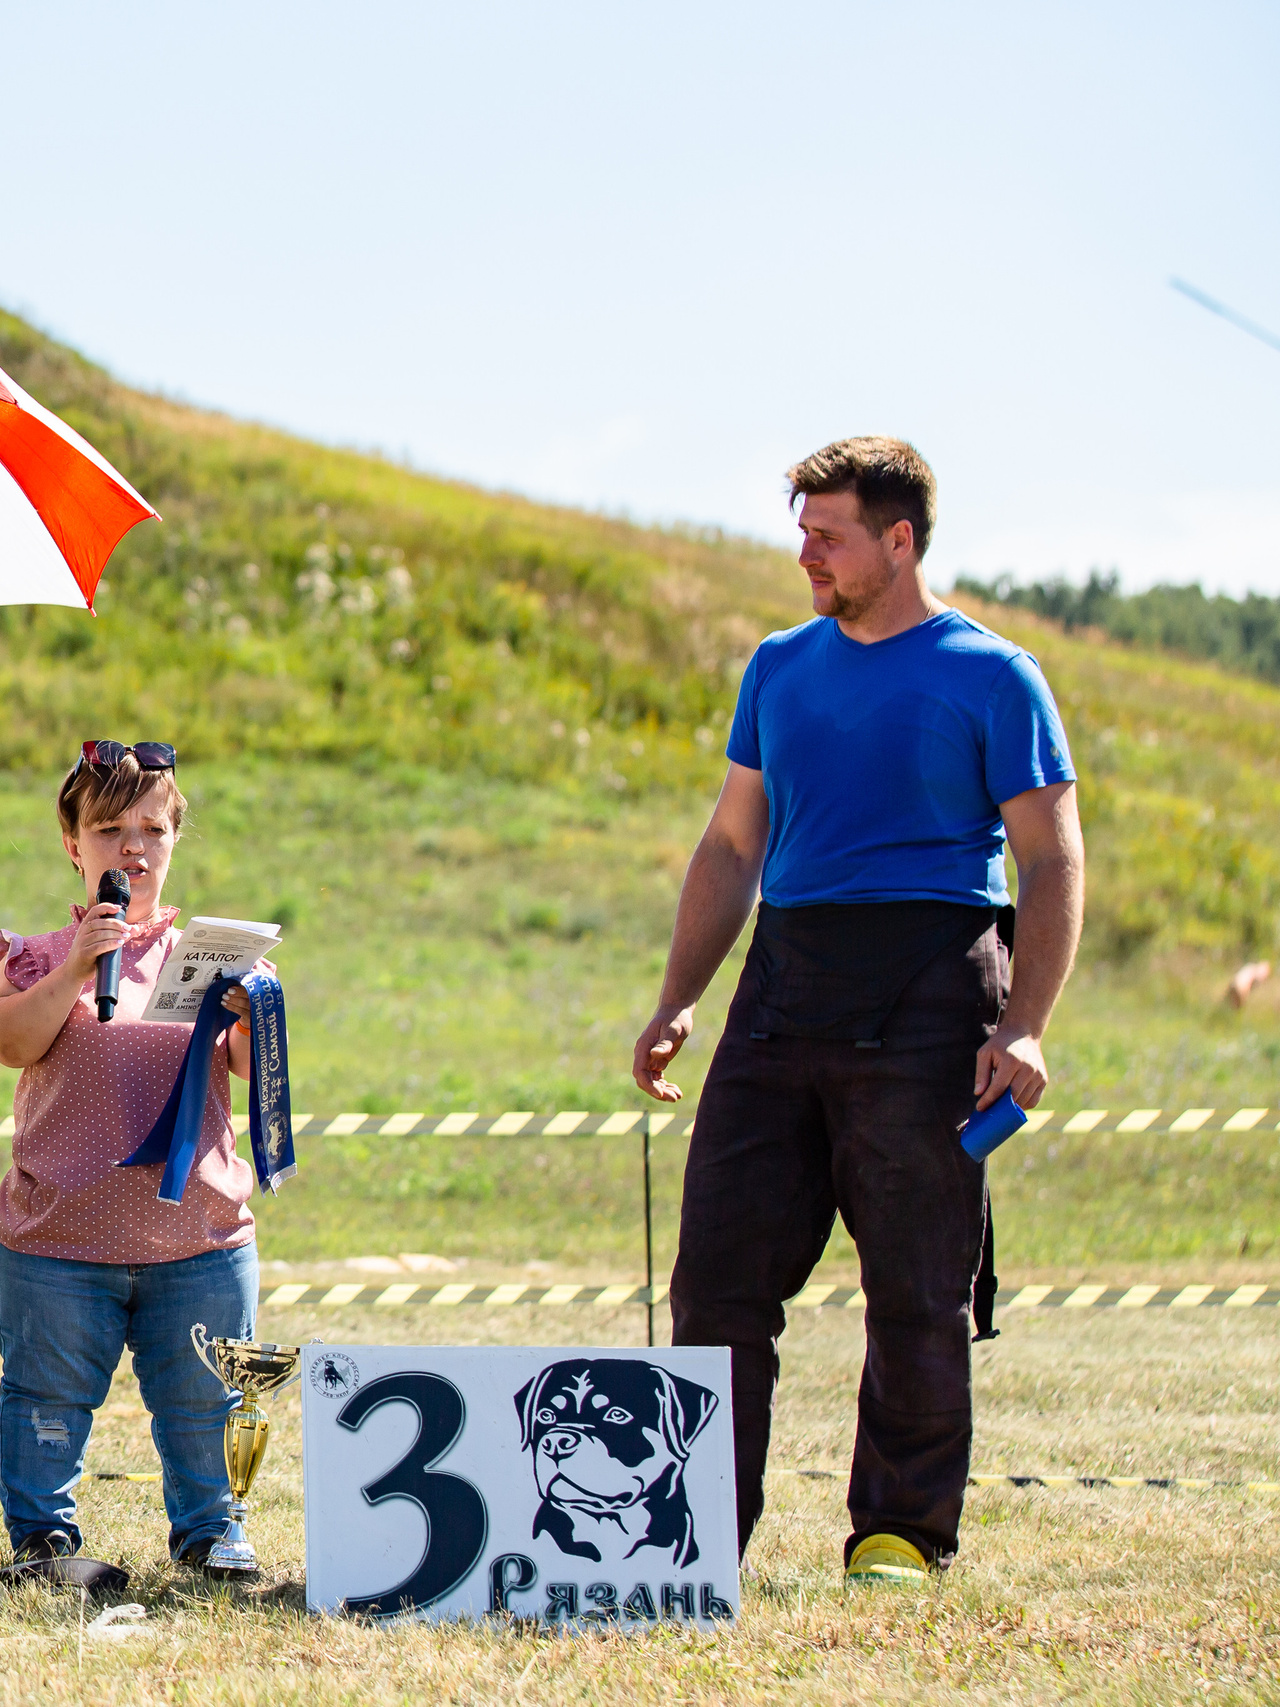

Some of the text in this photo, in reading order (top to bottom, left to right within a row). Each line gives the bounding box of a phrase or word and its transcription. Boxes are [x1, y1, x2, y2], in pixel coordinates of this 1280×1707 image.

[183, 952, 244, 962] КАТАЛОГ
[252, 992, 269, 1113] Межрегиональный
[266, 1011, 281, 1072] Самый
[336, 1370, 488, 1617] 3
